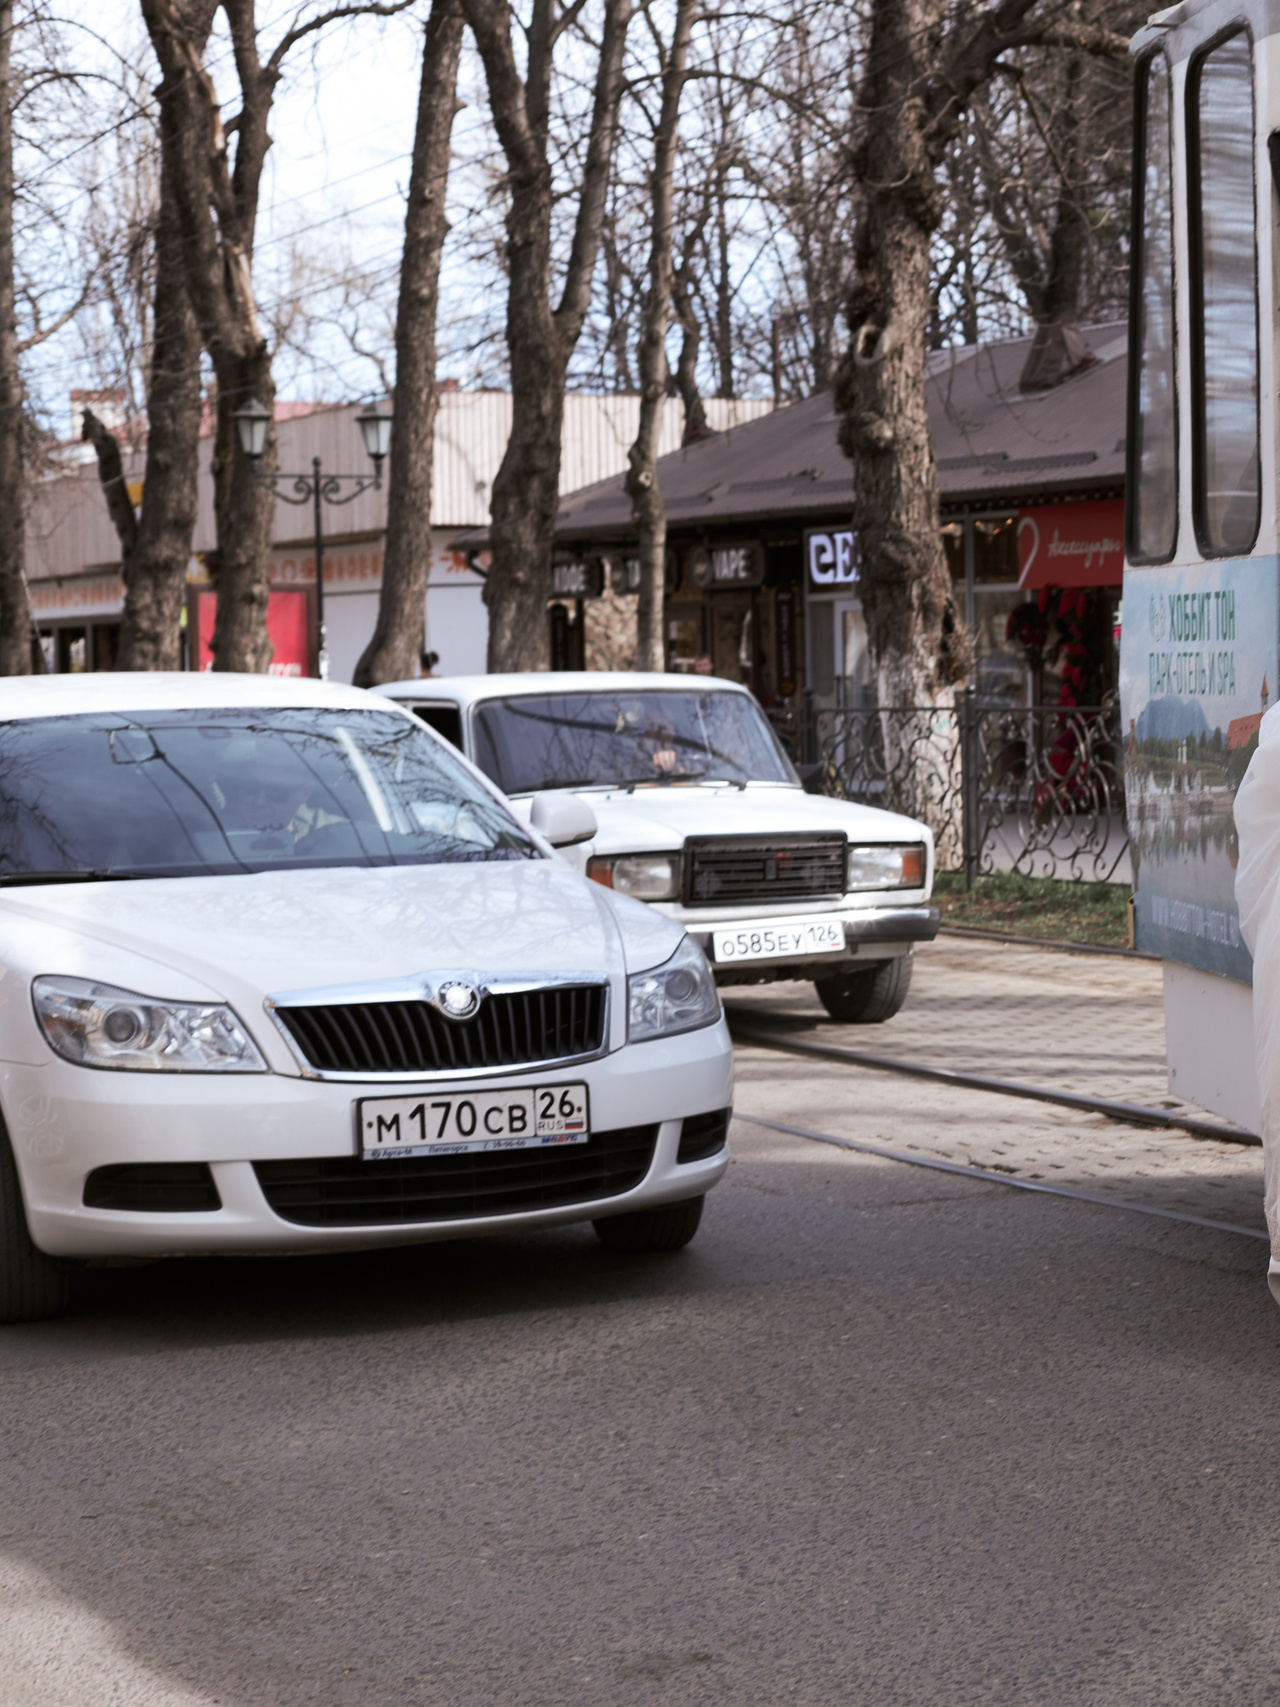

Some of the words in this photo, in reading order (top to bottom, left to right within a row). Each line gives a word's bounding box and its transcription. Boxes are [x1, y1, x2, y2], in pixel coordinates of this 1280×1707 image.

[712, 548, 748, 580] VAPE
[1168, 592, 1211, 642] ХОББИТ
[1214, 590, 1236, 641] ТОН
[1149, 652, 1206, 695] ПАРК-ОТЕЛЬ
[1208, 651, 1216, 695] И
[1217, 651, 1236, 696] SPA
[722, 931, 802, 957] О585ЕУ
[808, 925, 838, 943] 126
[376, 1100, 528, 1143] М170СВ
[539, 1090, 575, 1120] 26
[537, 1119, 564, 1133] RUS
